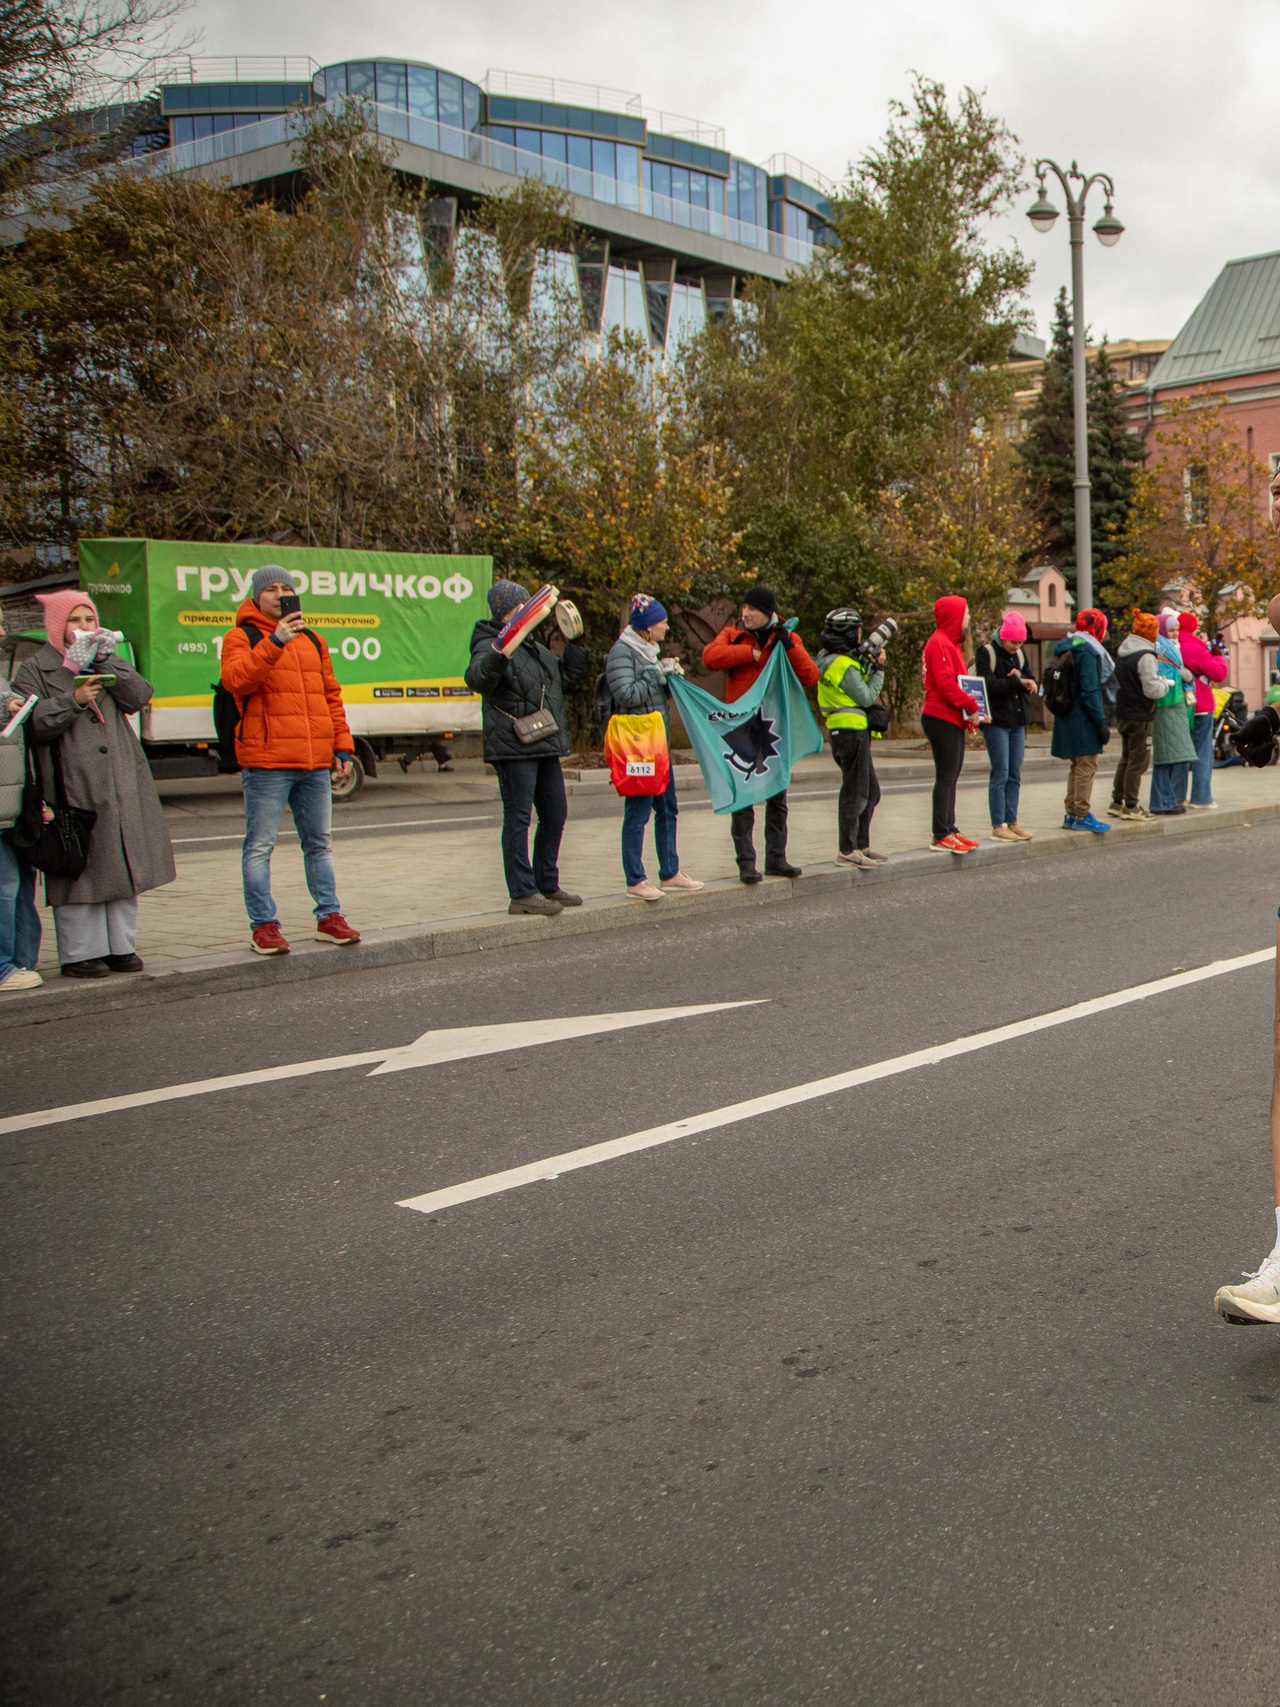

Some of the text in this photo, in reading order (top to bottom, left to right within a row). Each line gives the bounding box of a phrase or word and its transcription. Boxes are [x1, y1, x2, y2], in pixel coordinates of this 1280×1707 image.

[176, 565, 474, 603] груовичкоф
[184, 615, 233, 624] приедем
[178, 643, 207, 654] (495)
[630, 766, 651, 774] 6112
